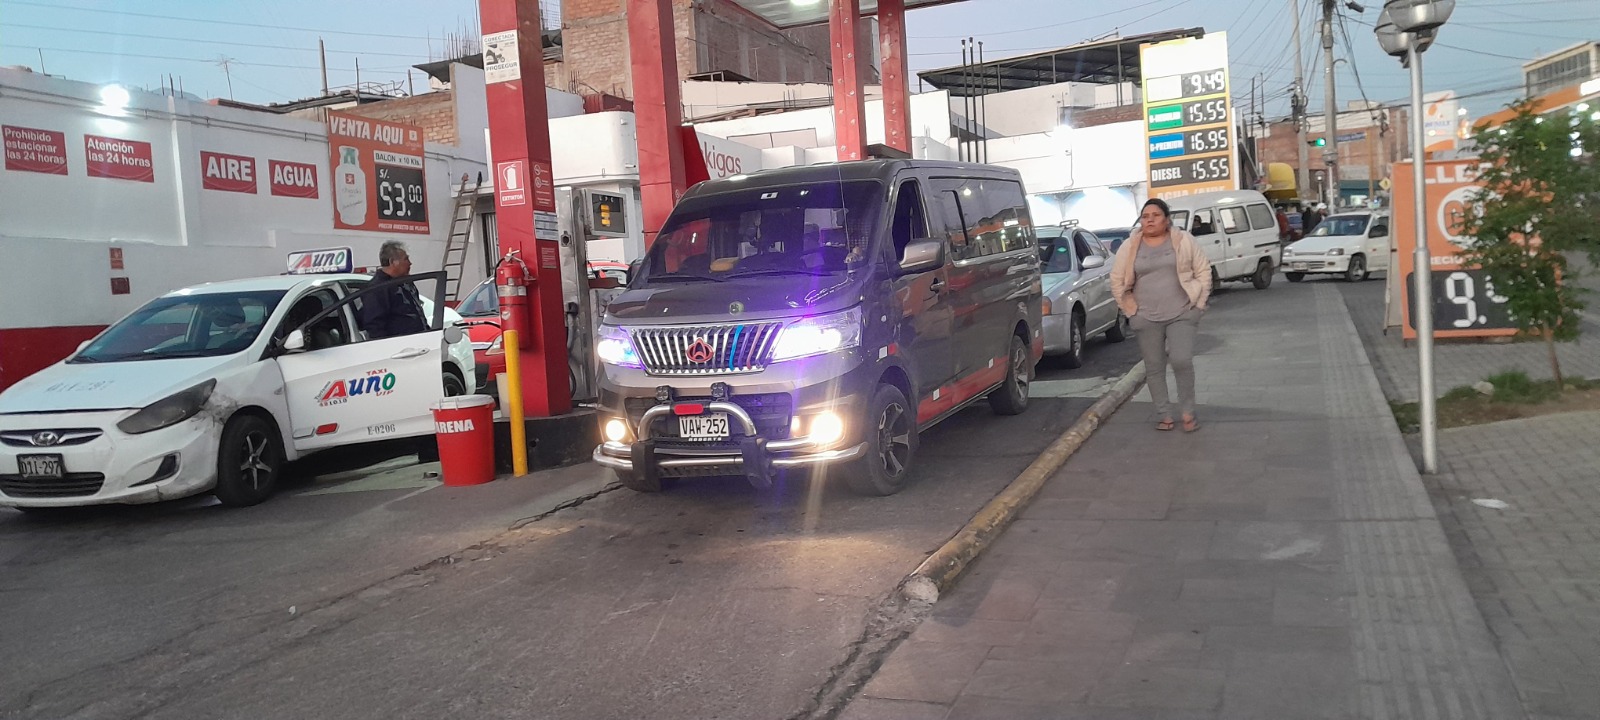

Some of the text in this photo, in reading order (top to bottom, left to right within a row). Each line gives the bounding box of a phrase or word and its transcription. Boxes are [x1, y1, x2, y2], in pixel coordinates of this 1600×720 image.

[486, 62, 517, 71] PROSEGUR
[1191, 71, 1225, 94] 9.49
[1189, 100, 1227, 122] 15.55
[4, 127, 52, 142] Prohibido
[330, 115, 404, 146] VENTA AQUI
[5, 141, 58, 154] estacionar
[87, 138, 134, 154] Atención
[1191, 129, 1228, 151] 16.95
[6, 149, 66, 165] las 24 horas
[88, 150, 151, 168] las 24 horas
[206, 156, 253, 182] AIRE
[273, 164, 315, 188] AGUA
[1151, 158, 1229, 181] DIESEL 15.55
[294, 251, 345, 269] Auno
[366, 368, 388, 376] TAXI
[321, 372, 396, 400] Auno
[367, 423, 396, 436] E-0206
[435, 418, 475, 434] ARENA
[681, 418, 727, 435] VAW-252
